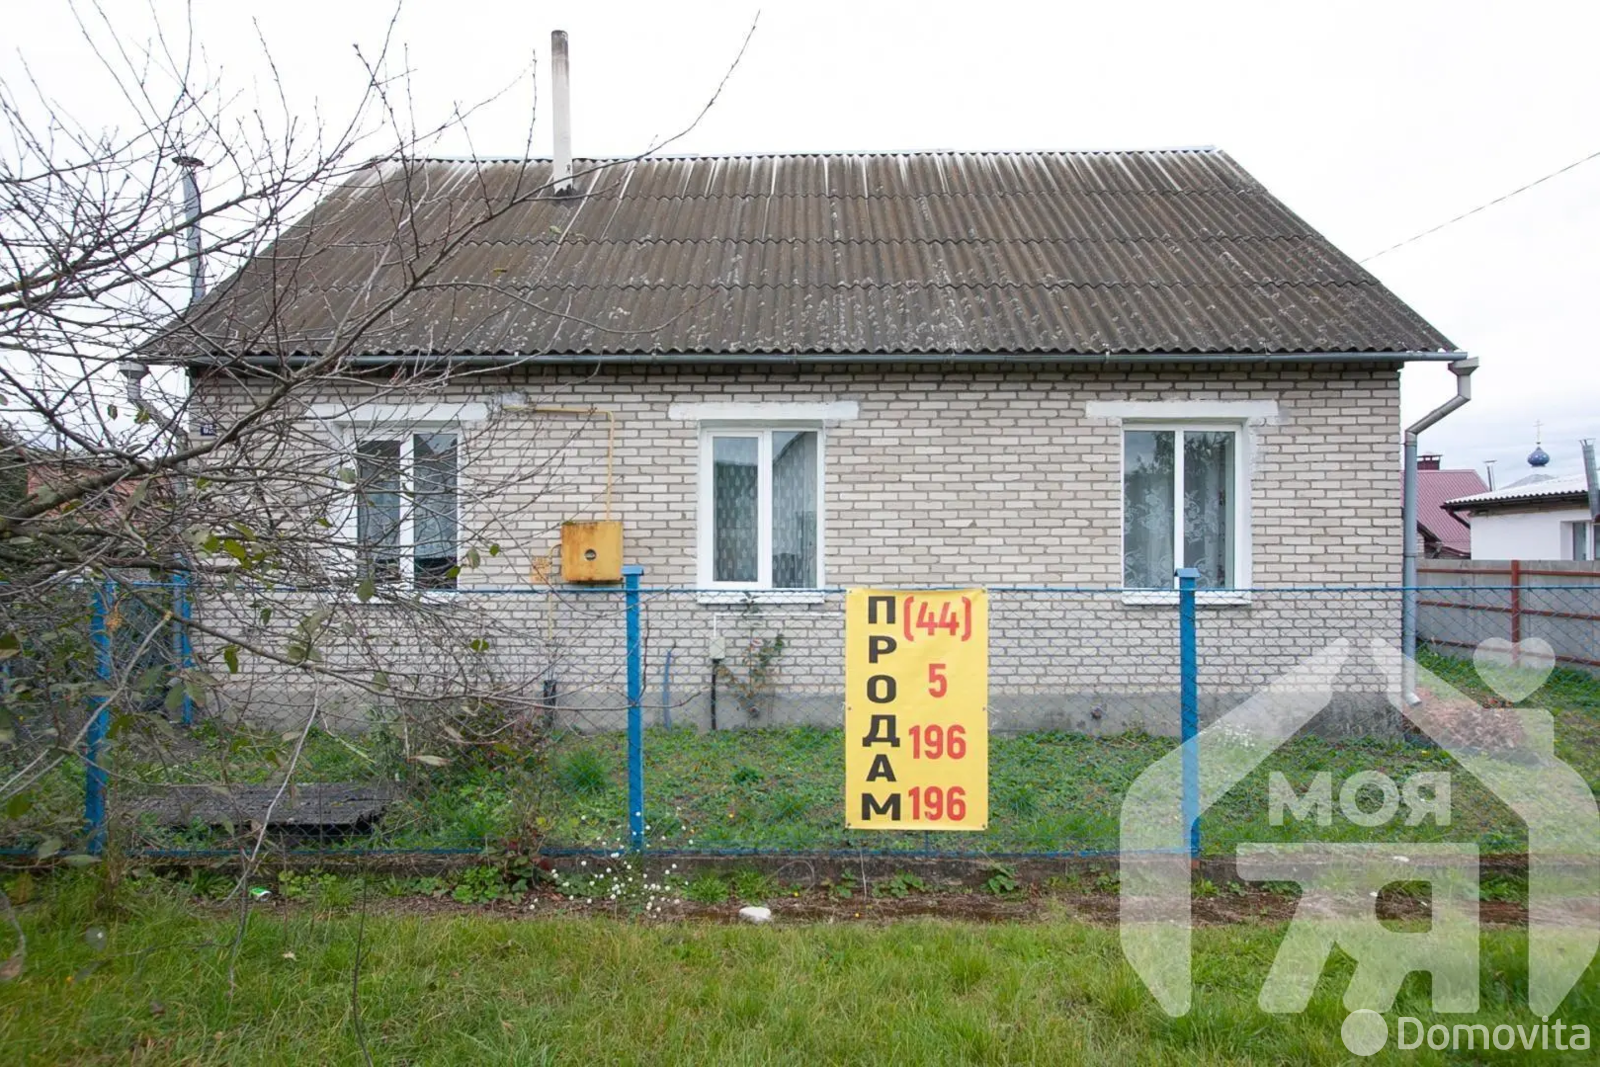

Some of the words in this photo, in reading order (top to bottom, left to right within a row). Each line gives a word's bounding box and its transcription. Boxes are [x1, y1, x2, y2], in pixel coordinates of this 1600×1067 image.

[904, 596, 972, 642] (44)
[928, 663, 948, 698] 5
[862, 596, 901, 821] ПРОДАМ
[908, 724, 967, 760] 196
[908, 786, 967, 821] 196
